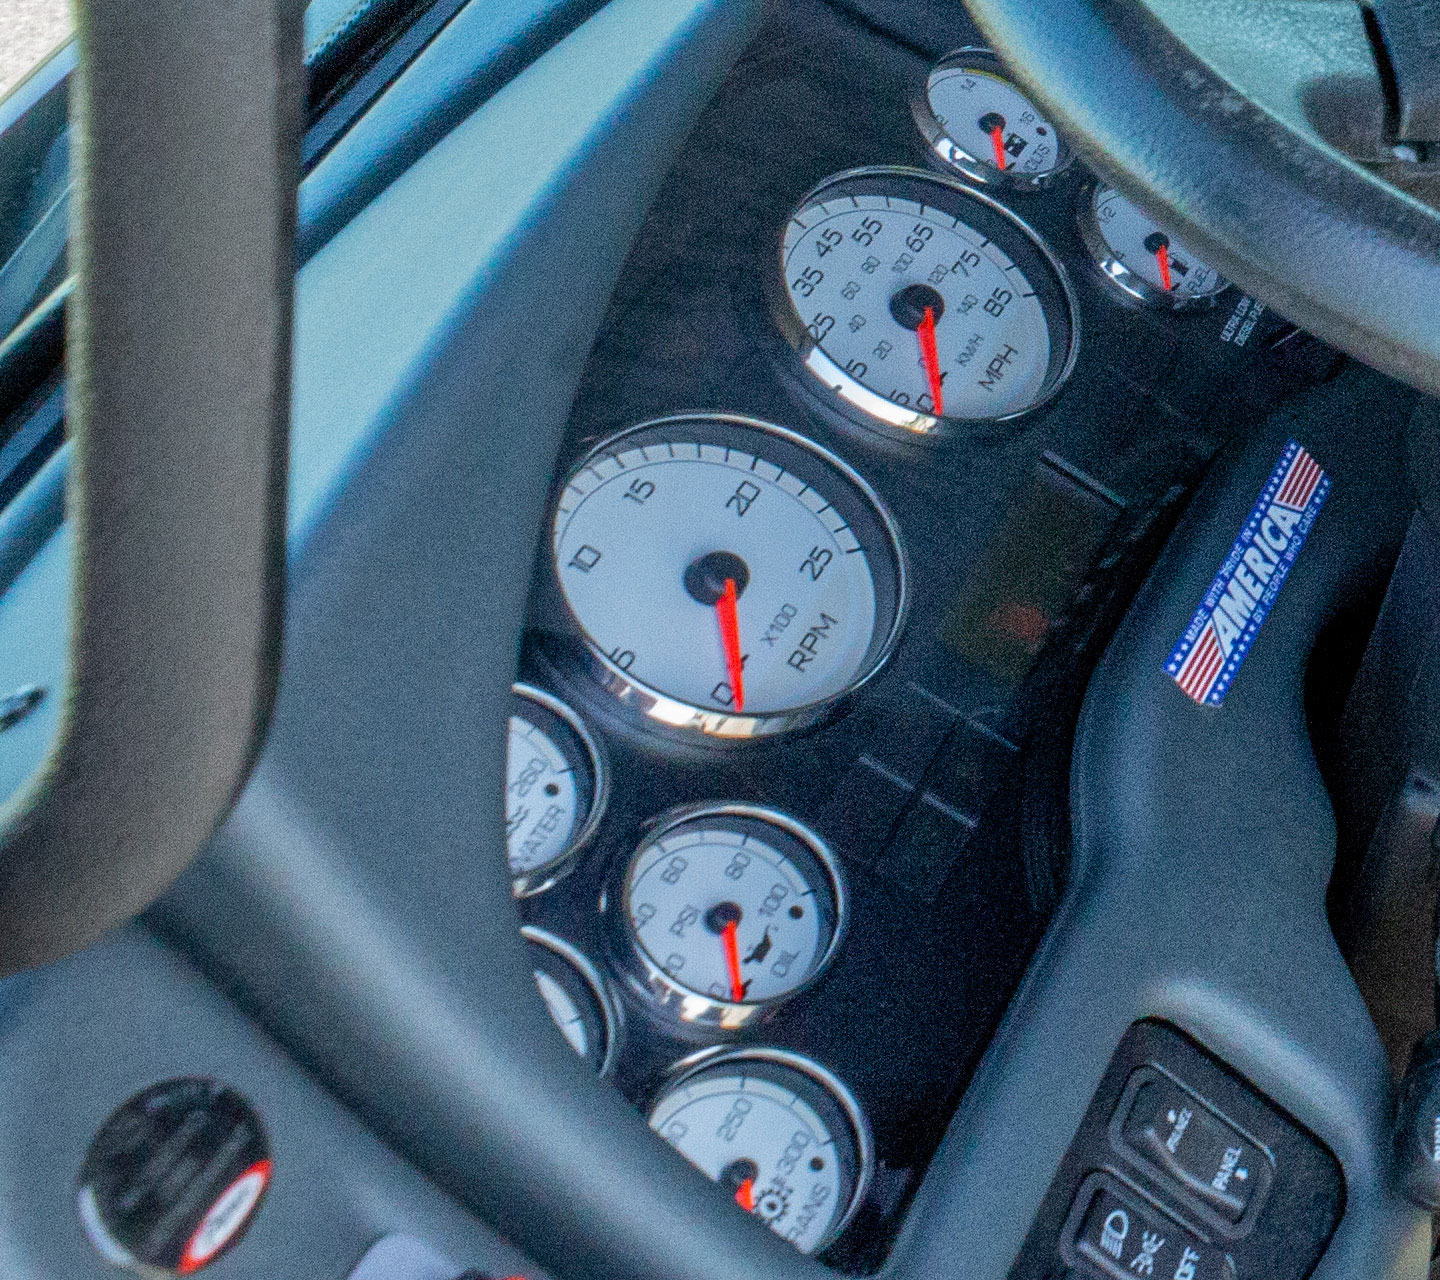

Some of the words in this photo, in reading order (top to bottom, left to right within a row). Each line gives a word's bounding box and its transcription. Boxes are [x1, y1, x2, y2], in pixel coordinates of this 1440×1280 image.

[815, 227, 843, 258] 45
[852, 216, 882, 247] 55
[906, 223, 934, 252] 65
[861, 255, 881, 274] 80
[892, 252, 914, 273] 100
[928, 264, 950, 285] 120
[951, 249, 981, 277] 75
[792, 266, 824, 297] 35
[842, 281, 861, 300] 60
[956, 294, 979, 316] 140
[983, 287, 1013, 317] 85
[873, 341, 892, 361] 20
[978, 343, 1019, 391] MPH
[624, 478, 656, 505] 15
[726, 480, 760, 517] 20
[569, 544, 601, 573] 10
[799, 545, 833, 582] 25
[1253, 606, 1266, 624] BY
[1263, 564, 1289, 607] PEOPLE
[1287, 536, 1303, 563] WHO
[1300, 507, 1318, 535] CARE
[1186, 609, 1209, 640] MADE
[1207, 577, 1224, 608] WITH
[1221, 544, 1245, 577] PRIDE
[1241, 528, 1252, 541] IN
[1212, 504, 1303, 659] AMERICA
[788, 613, 838, 673] RPM
[660, 857, 689, 885] 60
[724, 853, 751, 881] 80
[760, 883, 790, 918] 100
[670, 905, 701, 938] PSI
[716, 1098, 752, 1142] 250
[777, 1130, 812, 1176] 300
